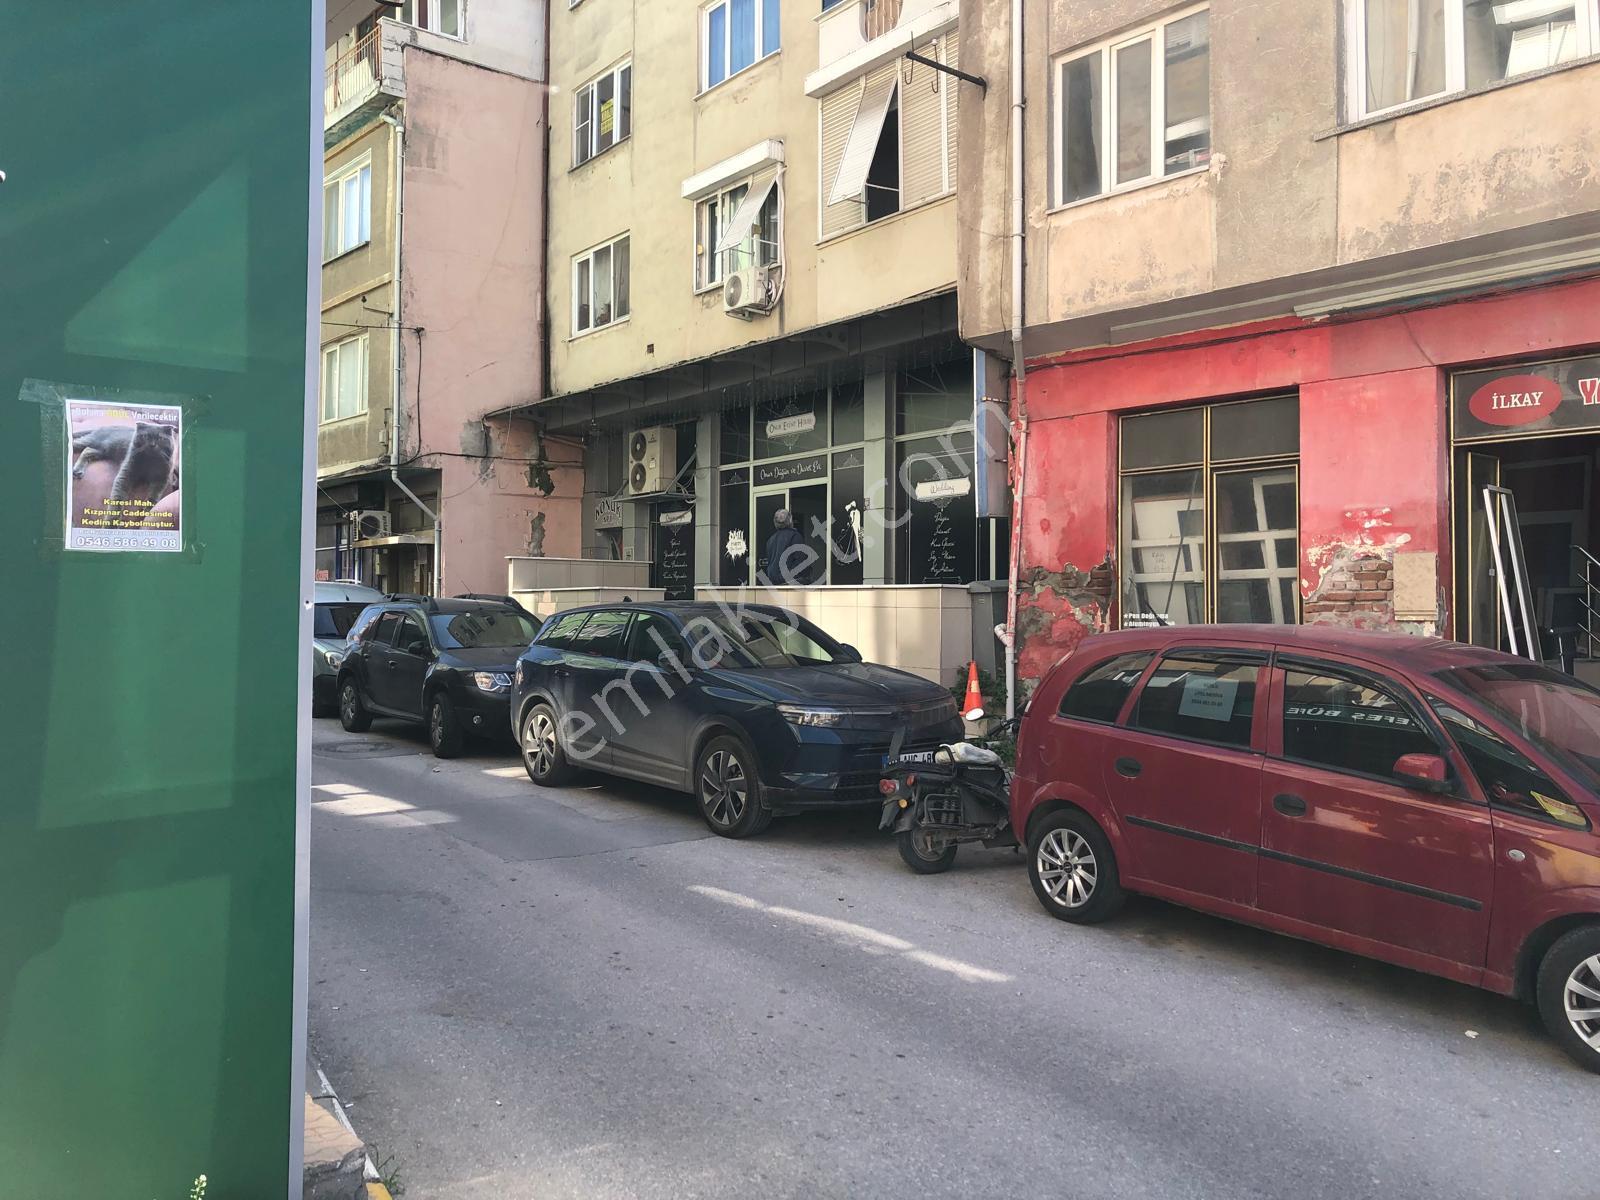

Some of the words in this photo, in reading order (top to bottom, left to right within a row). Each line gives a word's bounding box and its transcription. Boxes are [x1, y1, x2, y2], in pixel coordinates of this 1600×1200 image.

[1491, 391, 1544, 410] İLKAY
[1578, 377, 1600, 405] Y
[103, 498, 132, 506] Karesi
[122, 509, 173, 518] Caddesinde
[81, 518, 111, 527] Kedim
[112, 519, 175, 529] Kaybolmuştur.
[76, 536, 110, 547] 0546
[113, 538, 138, 548] 586
[141, 539, 157, 548] 49
[160, 539, 177, 549] 08
